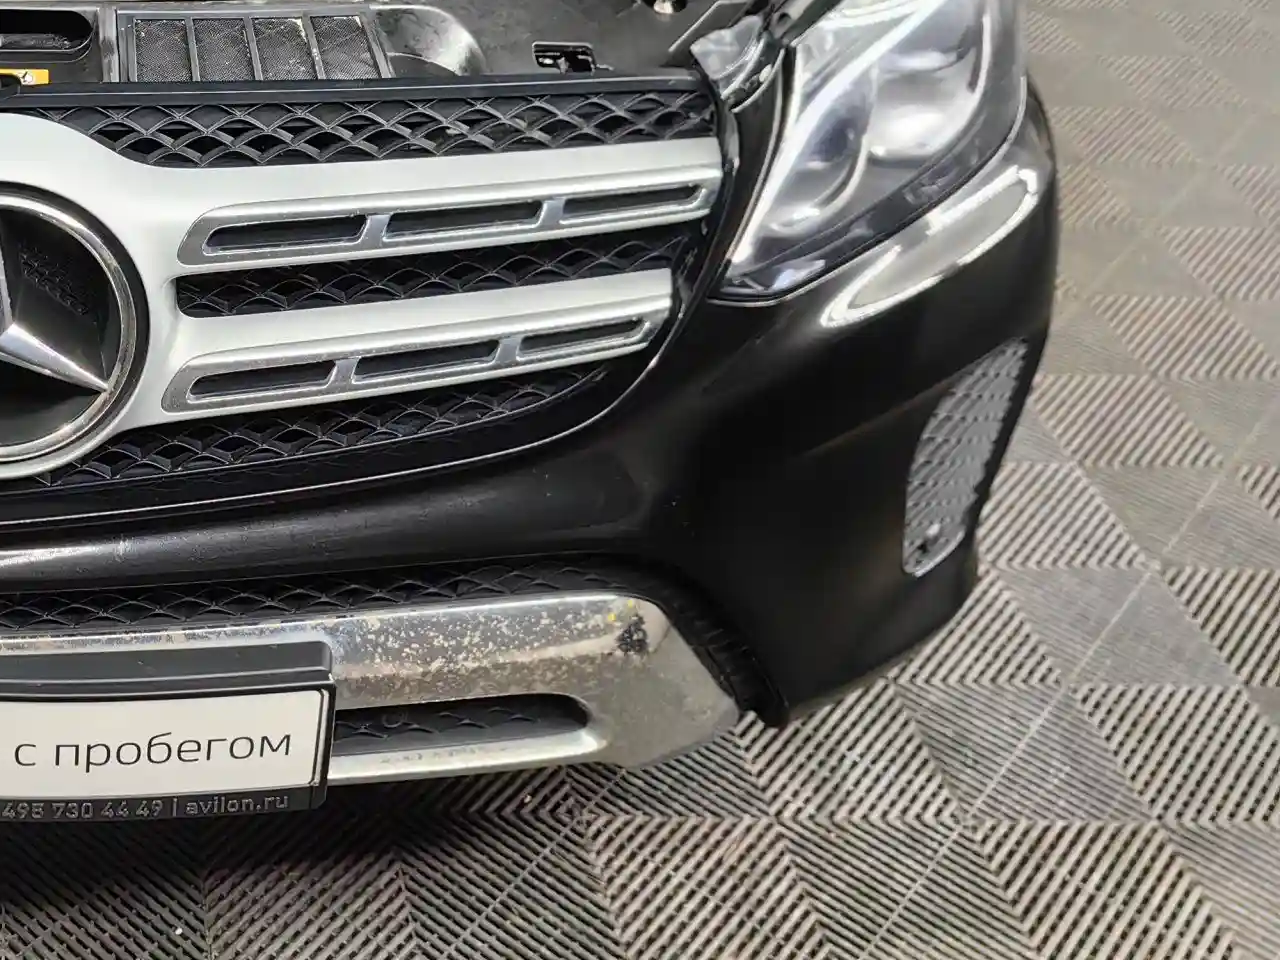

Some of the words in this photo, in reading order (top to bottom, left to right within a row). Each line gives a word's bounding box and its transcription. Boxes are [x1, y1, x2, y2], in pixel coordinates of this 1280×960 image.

[14, 743, 37, 767] с
[54, 731, 292, 774] пробегом
[1, 801, 45, 820] 495
[51, 801, 94, 820] 730
[100, 799, 130, 819] 44
[135, 799, 164, 818] 49
[185, 795, 289, 816] avilon.ru
